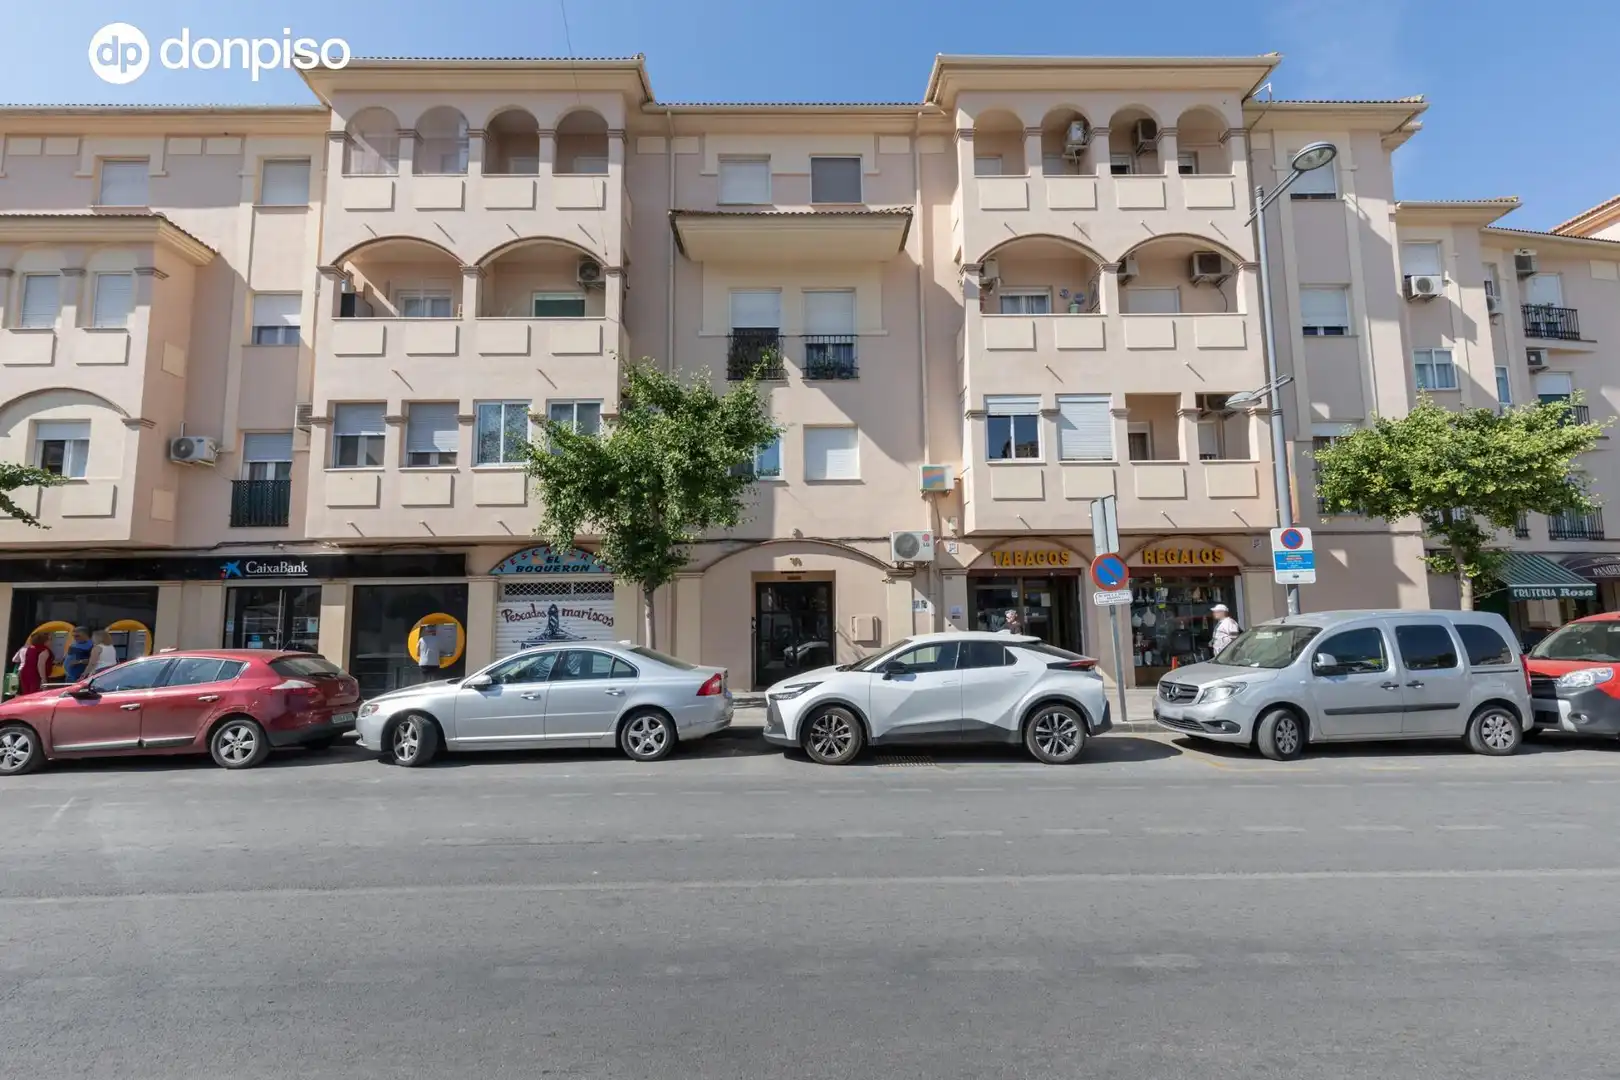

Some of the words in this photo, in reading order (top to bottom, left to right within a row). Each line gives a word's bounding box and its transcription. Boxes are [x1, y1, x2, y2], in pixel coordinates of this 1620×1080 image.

[499, 547, 605, 572] PESCAERA
[546, 556, 560, 564] EL
[990, 550, 1070, 567] TABACOS
[1142, 547, 1225, 565] REGALOS
[245, 560, 309, 574] CaixaBank
[515, 564, 590, 573] BOQUERON
[1513, 588, 1557, 598] FRUTERIA
[1560, 588, 1594, 597] Rosa
[501, 603, 547, 623] Pescados
[562, 607, 615, 627] mariscos
